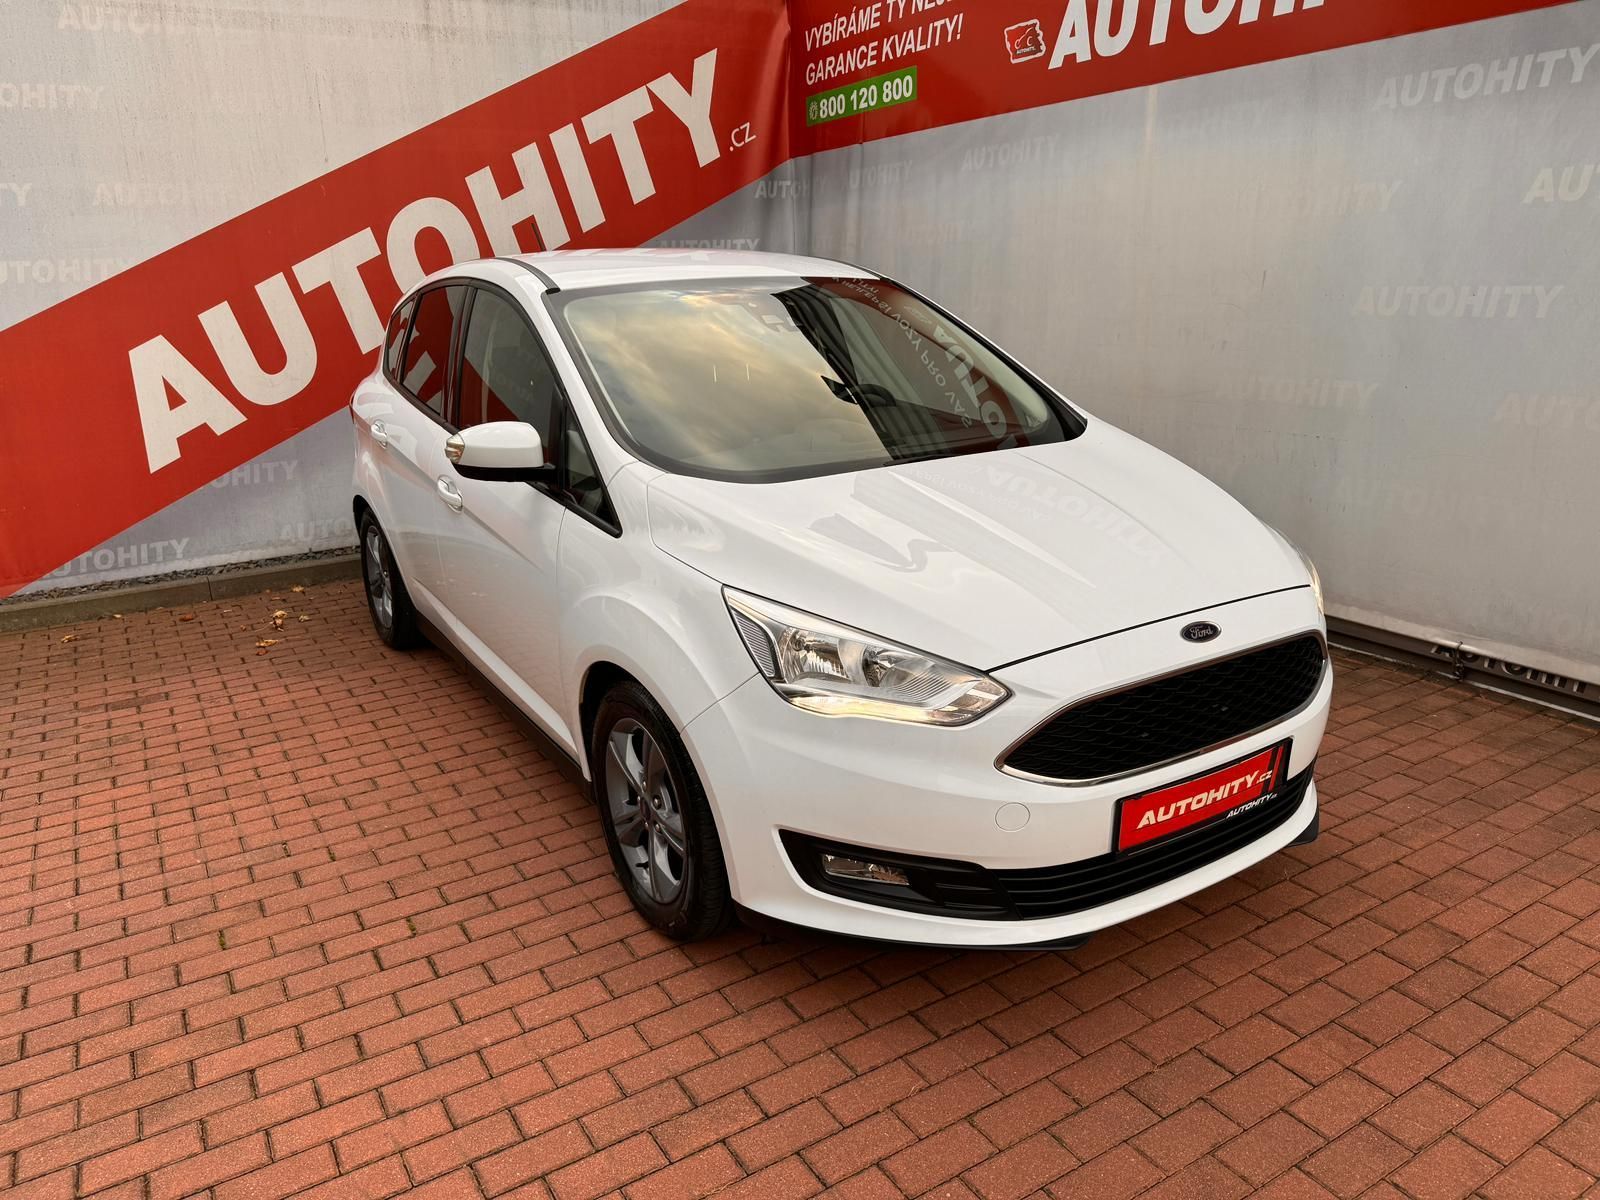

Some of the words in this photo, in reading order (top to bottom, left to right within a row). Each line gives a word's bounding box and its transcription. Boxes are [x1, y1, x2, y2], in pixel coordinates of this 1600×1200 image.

[805, 3, 882, 51] VYBÍRÁME
[887, 0, 906, 23] TY
[806, 41, 879, 86] GARANCE
[882, 13, 964, 62] KVALITY!
[819, 94, 846, 119] 800
[850, 85, 877, 111] 120
[882, 75, 913, 103] 800
[1372, 43, 1600, 112] AUTOHITY
[961, 133, 1060, 172] AUTOHITY
[1520, 164, 1600, 204] AU
[1351, 284, 1566, 320] AUTOHITY
[1190, 625, 1213, 639] Ford
